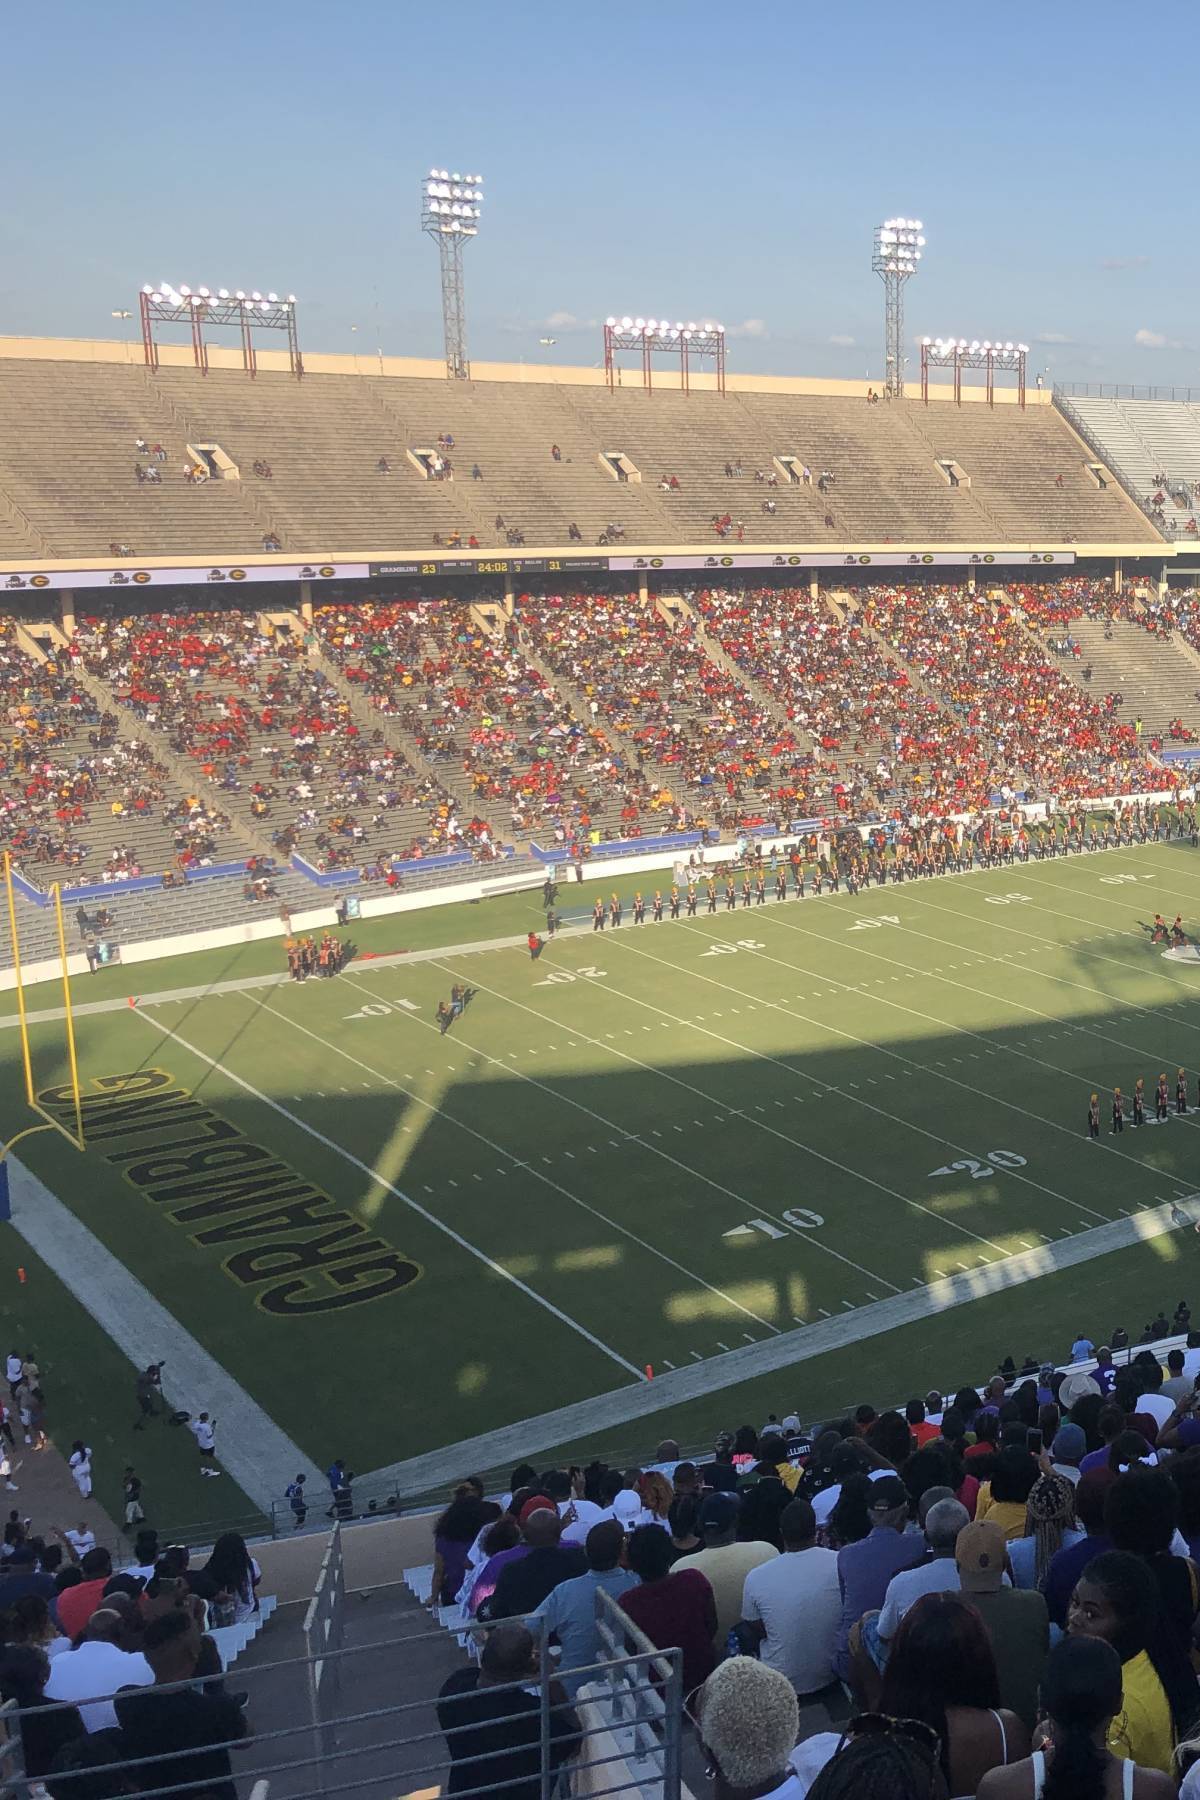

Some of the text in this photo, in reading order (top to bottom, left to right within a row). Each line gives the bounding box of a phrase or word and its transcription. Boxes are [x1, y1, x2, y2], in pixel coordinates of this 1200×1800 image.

[422, 564, 436, 575] 23
[478, 562, 508, 572] 24:02
[548, 561, 561, 570] 31
[1099, 873, 1138, 885] 40
[984, 892, 1033, 905] 50
[855, 914, 901, 929] 40
[709, 939, 767, 954] 30
[546, 966, 608, 983] 20
[360, 998, 422, 1016] 10
[951, 1150, 1028, 1179] 20
[38, 1067, 424, 1316] GRAMBLING
[747, 1208, 824, 1239] 10
